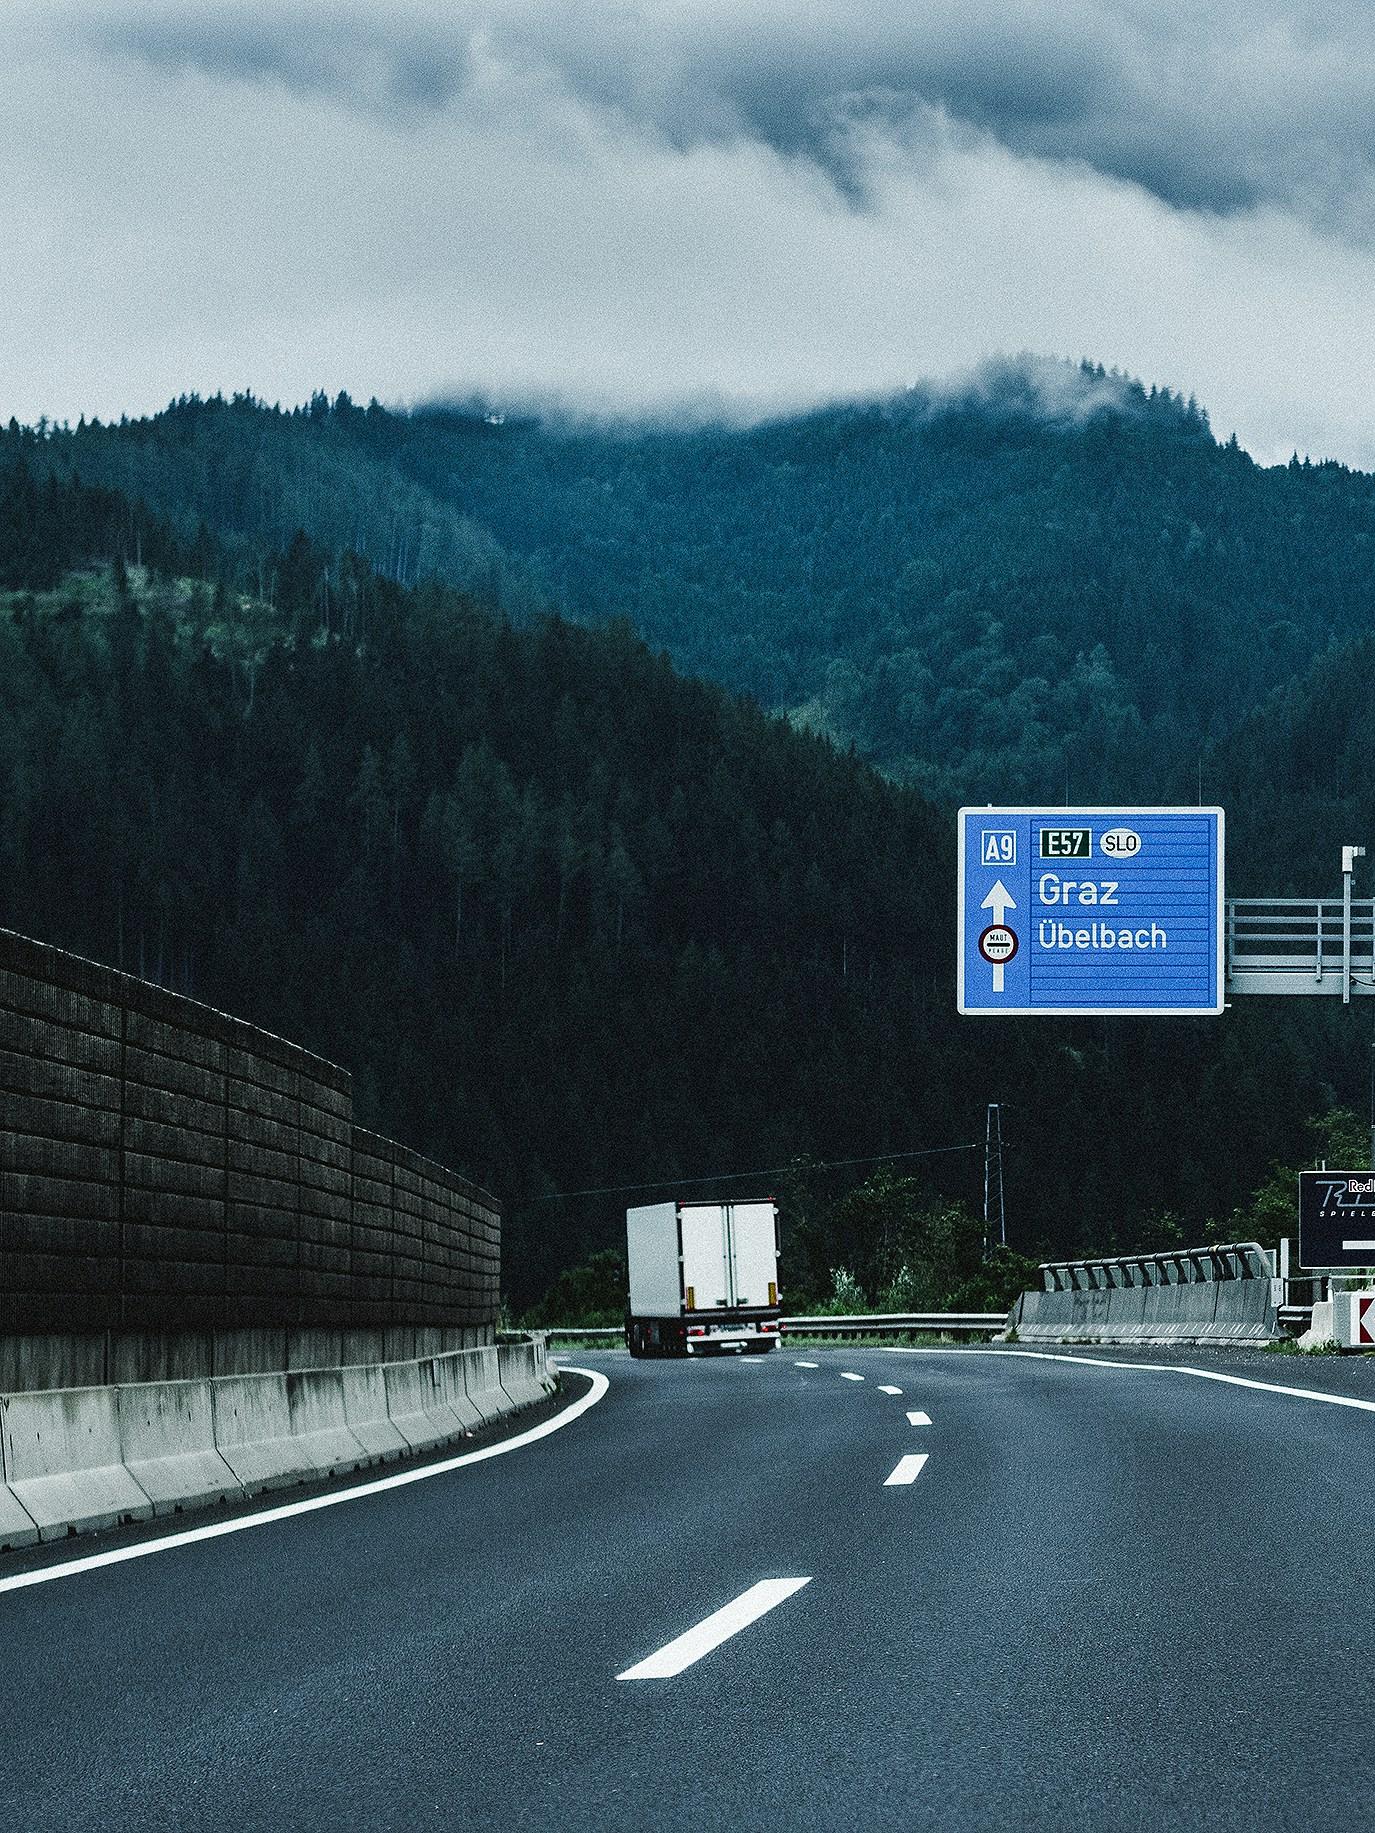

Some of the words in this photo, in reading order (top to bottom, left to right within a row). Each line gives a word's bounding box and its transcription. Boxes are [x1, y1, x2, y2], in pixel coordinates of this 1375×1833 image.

[985, 835, 1013, 861] A9
[1048, 832, 1083, 855] E57
[1105, 835, 1137, 852] SLO
[1039, 873, 1119, 906] Graz
[989, 933, 1008, 942] MAUT
[1039, 919, 1167, 949] Übelbach
[1349, 1179, 1373, 1193] Red
